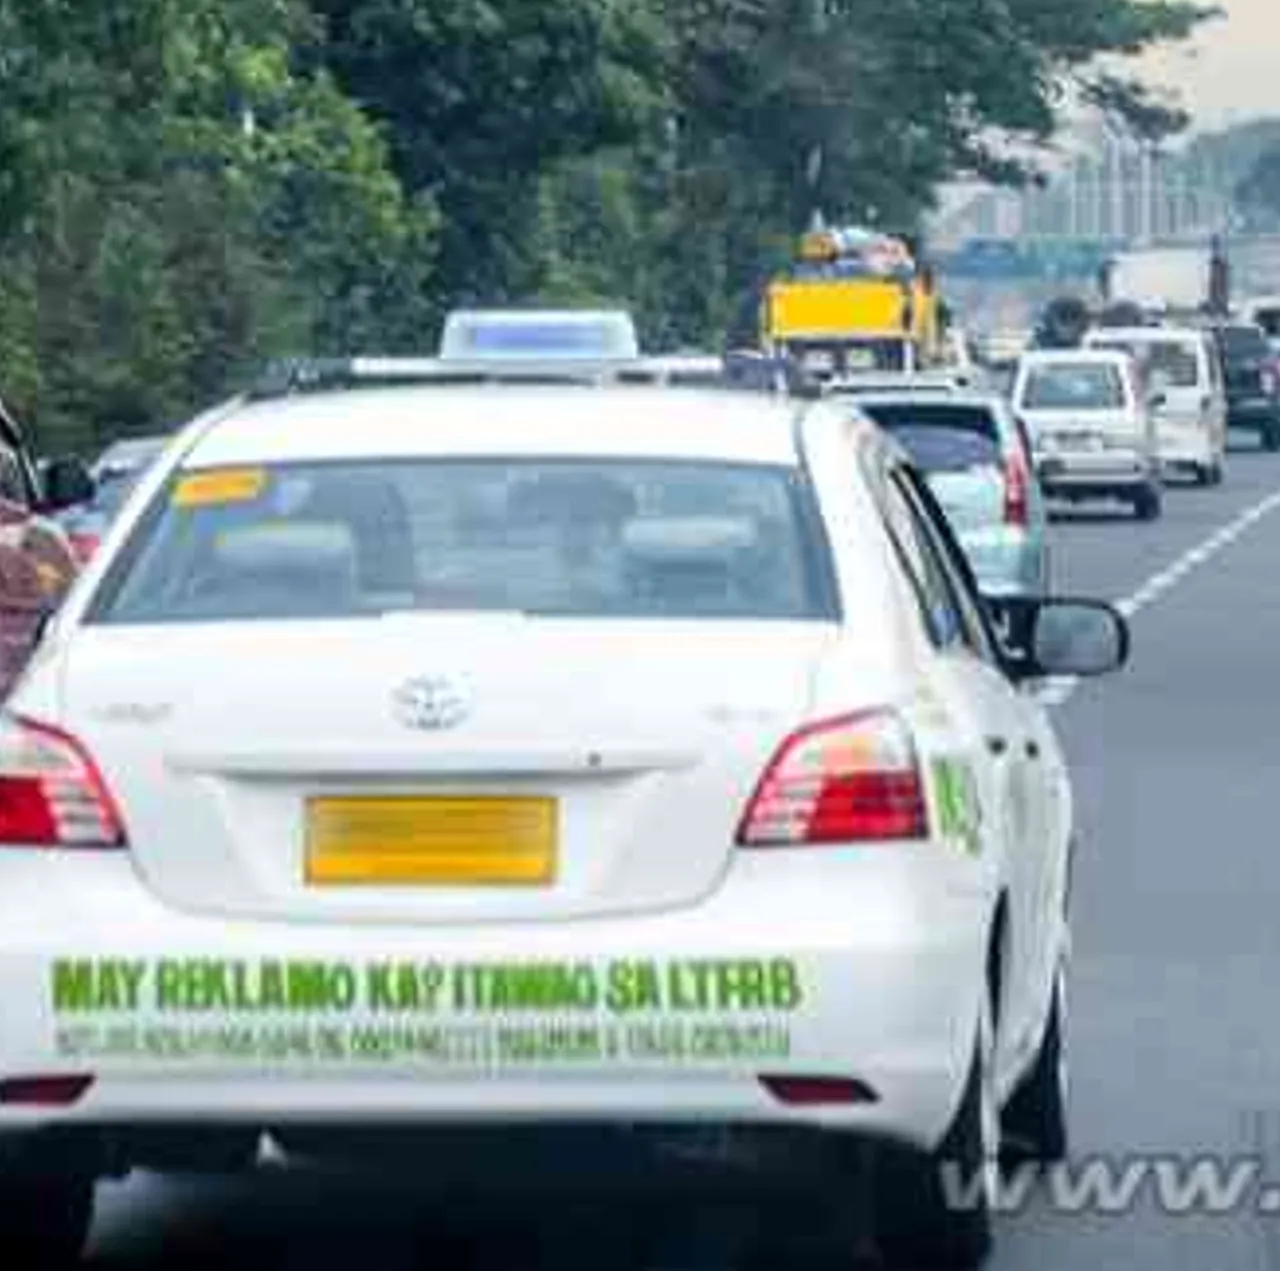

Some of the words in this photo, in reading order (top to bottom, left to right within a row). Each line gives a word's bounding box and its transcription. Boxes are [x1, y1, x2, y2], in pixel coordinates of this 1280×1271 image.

[53, 958, 144, 1009] MAY
[157, 958, 355, 1009] REKLAMO
[606, 956, 661, 1012] SA
[668, 958, 803, 1009] LTFRB
